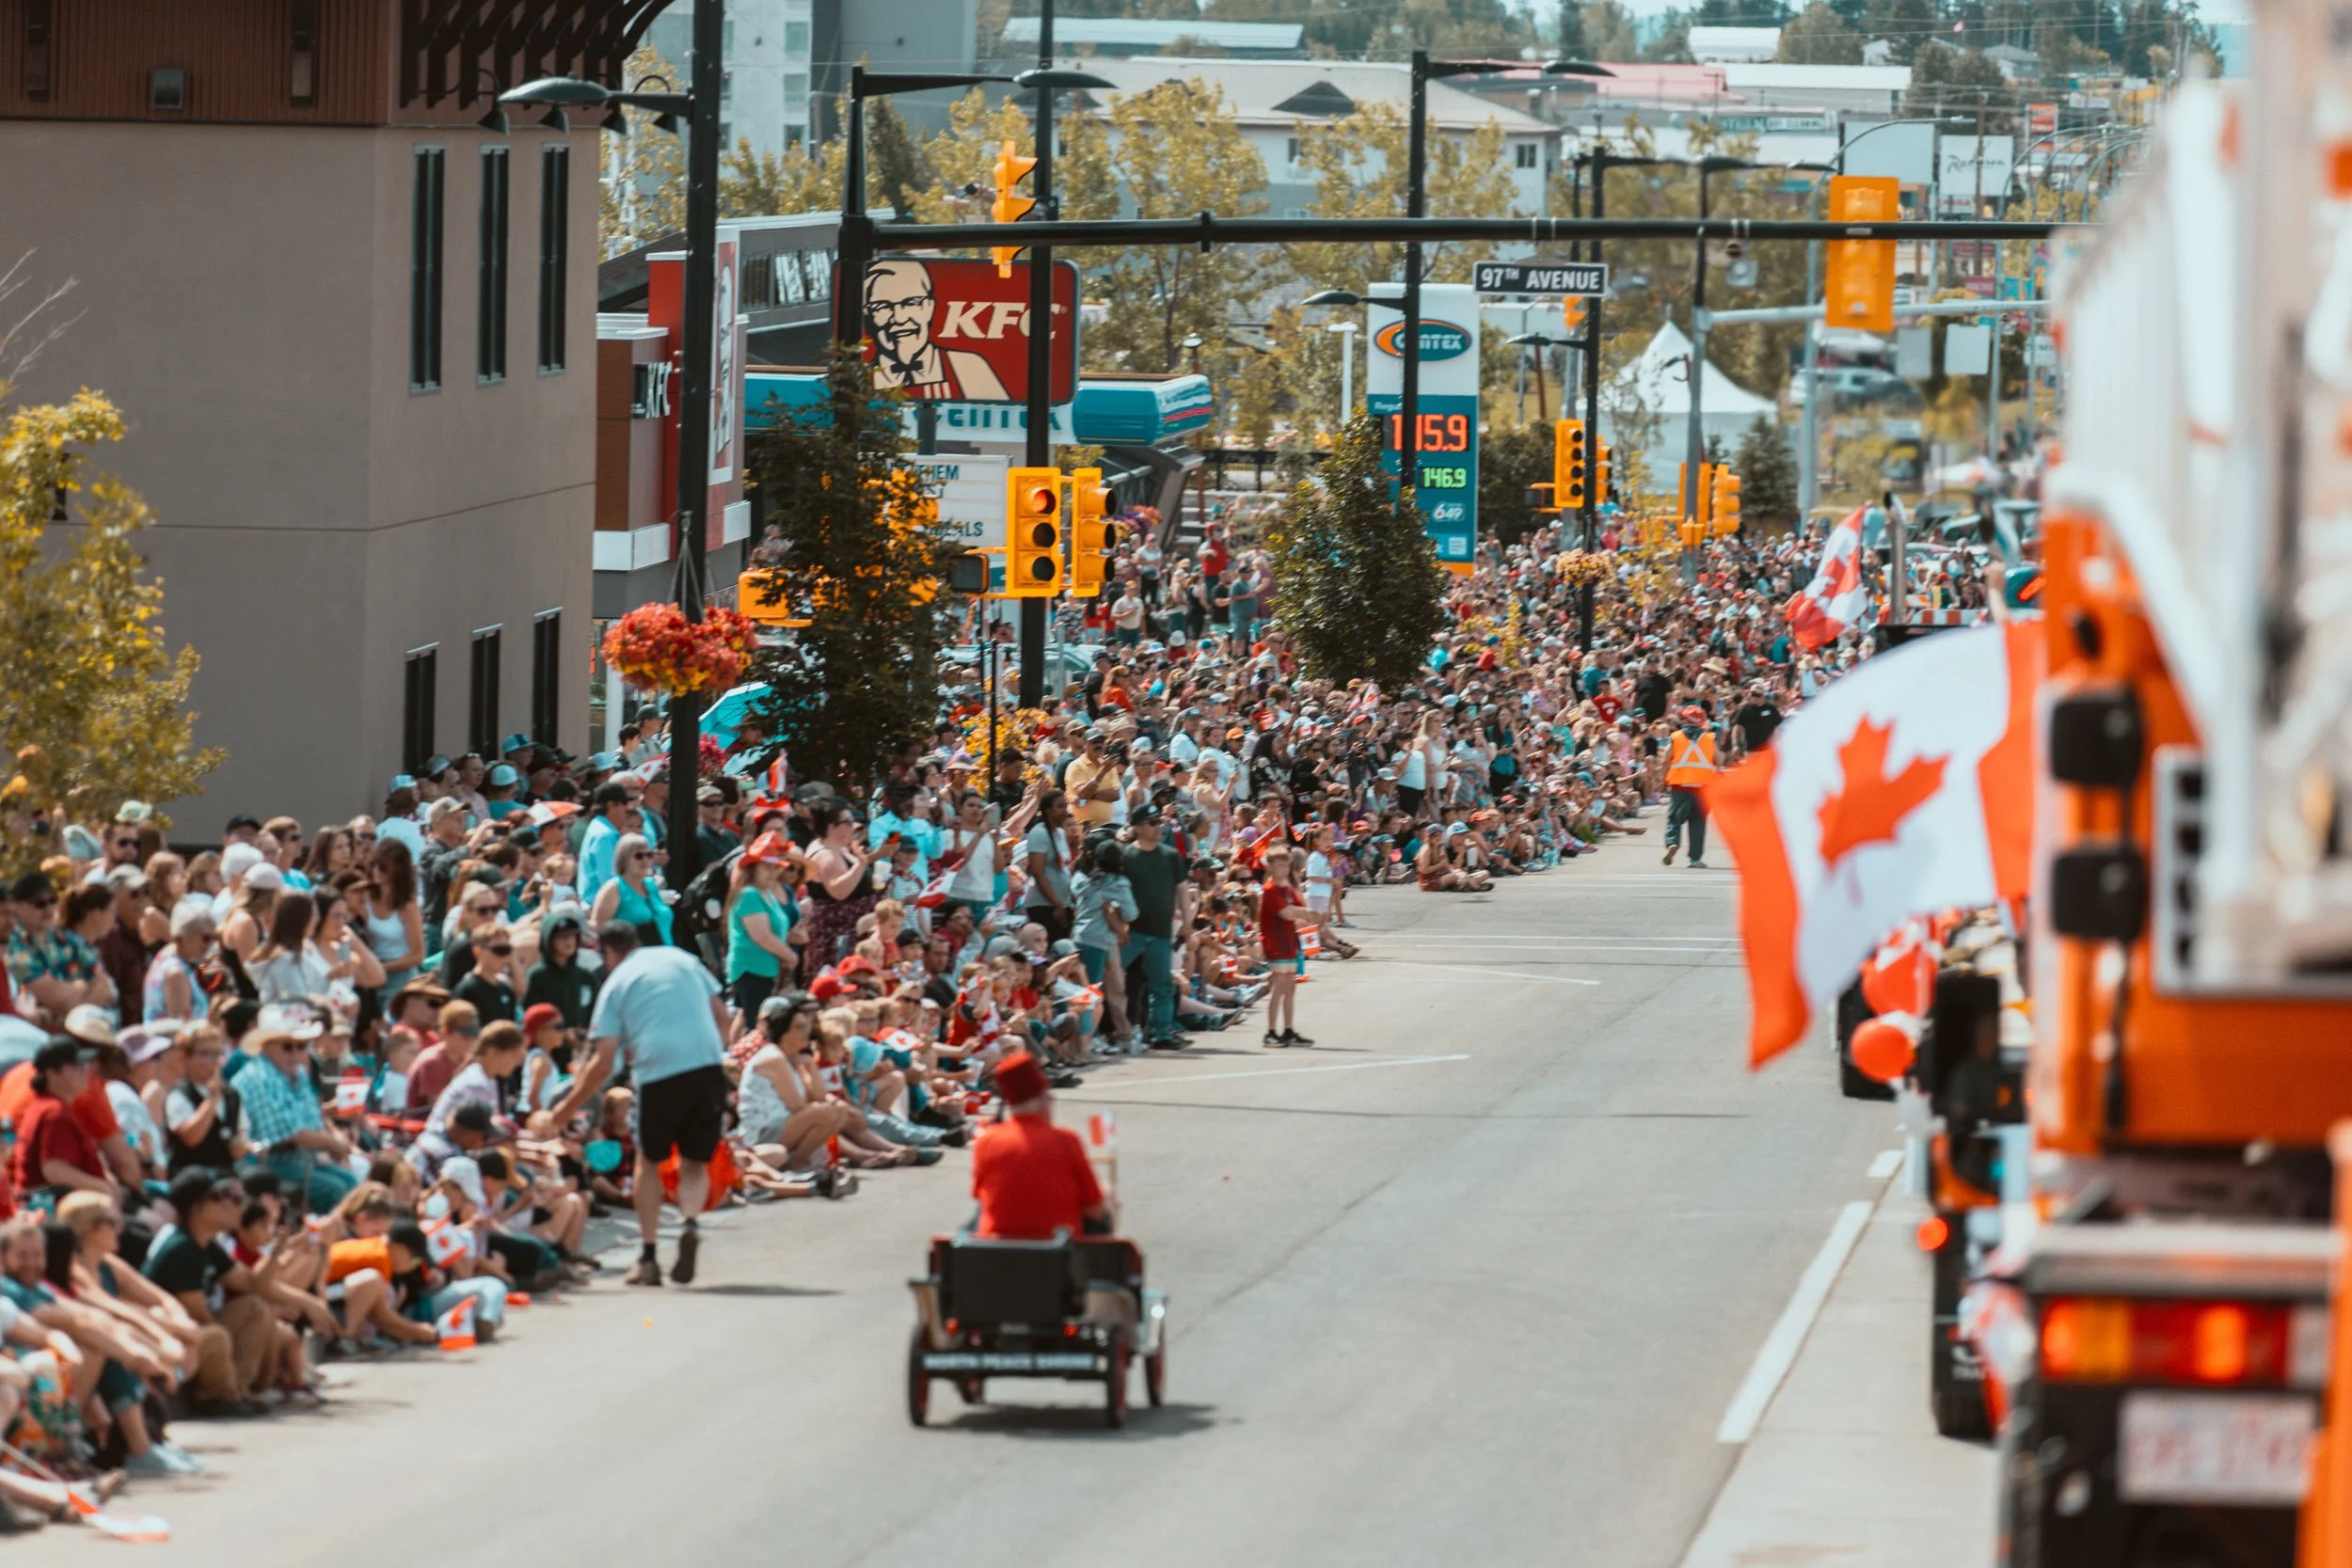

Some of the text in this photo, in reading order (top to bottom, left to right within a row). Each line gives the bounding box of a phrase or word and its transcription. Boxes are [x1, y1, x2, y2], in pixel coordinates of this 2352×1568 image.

[1481, 268, 1599, 290] 97TH AVENUE
[645, 360, 673, 420] KFC
[1391, 414, 1468, 452] 115.9
[1422, 467, 1467, 488] 146.9
